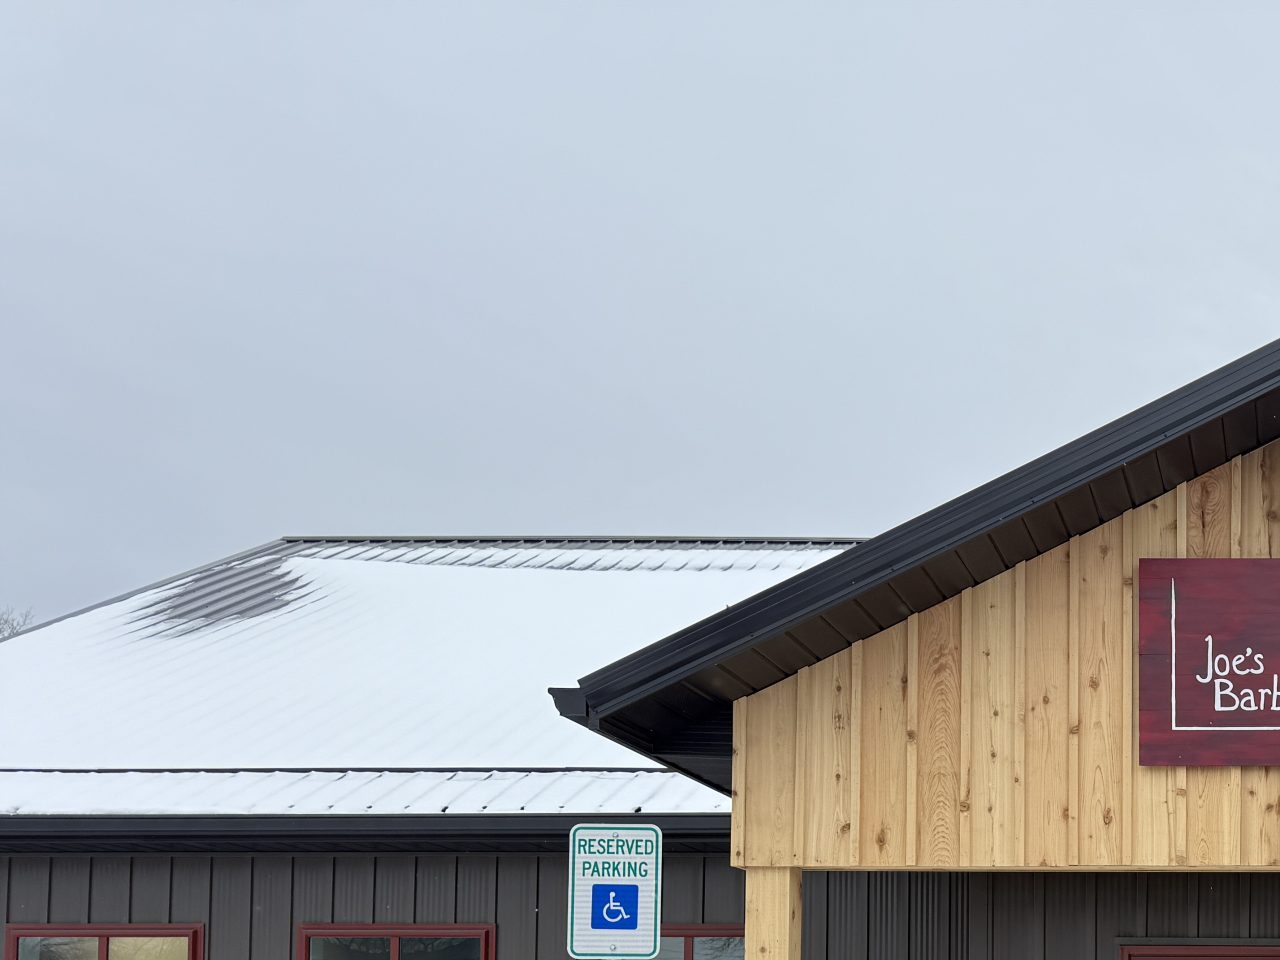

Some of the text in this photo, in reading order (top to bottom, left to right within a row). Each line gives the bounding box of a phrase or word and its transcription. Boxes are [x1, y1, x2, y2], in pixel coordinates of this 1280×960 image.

[1196, 635, 1264, 683] Joe's
[577, 838, 654, 855] RESERVED
[582, 861, 648, 878] PARKING
